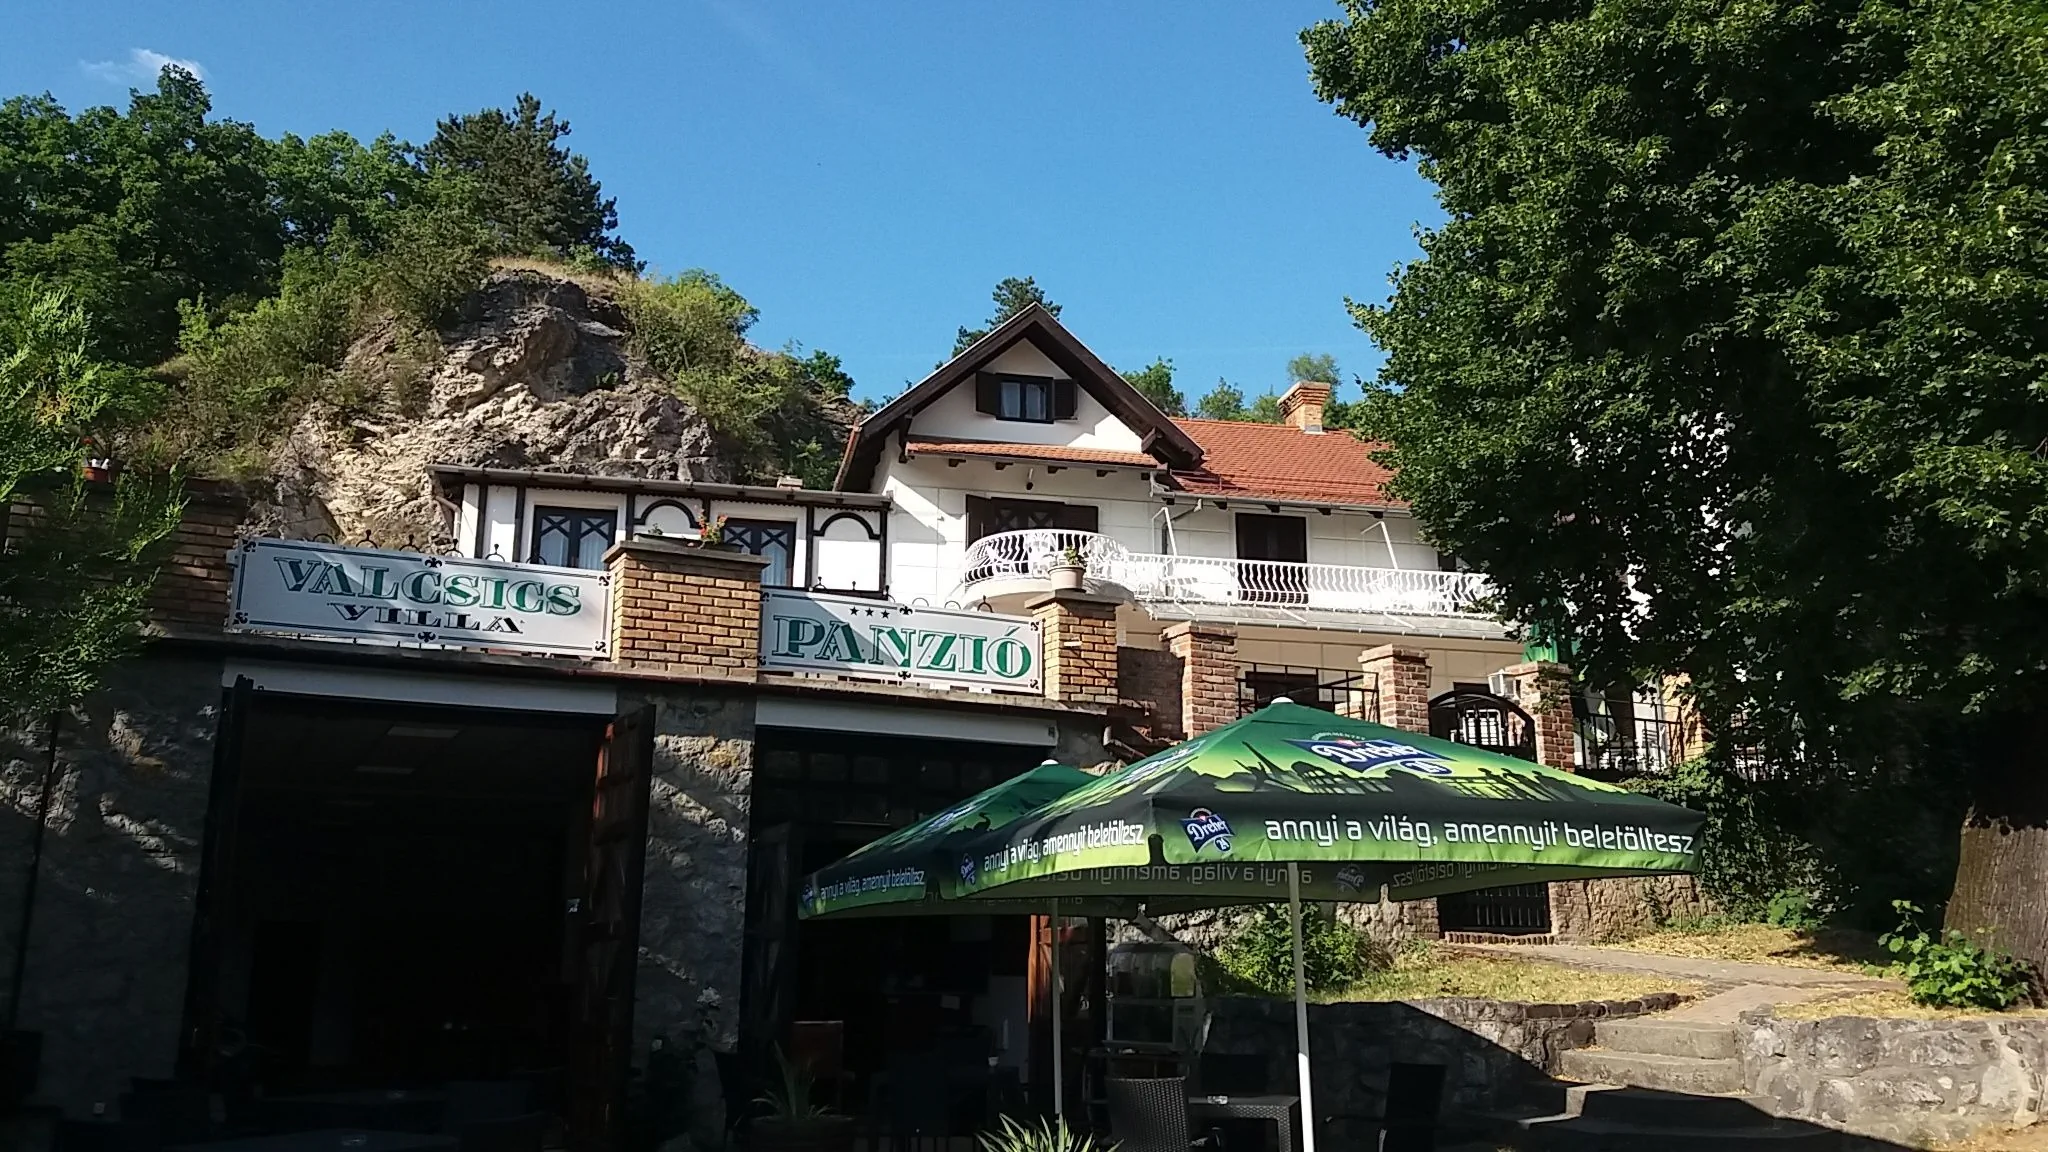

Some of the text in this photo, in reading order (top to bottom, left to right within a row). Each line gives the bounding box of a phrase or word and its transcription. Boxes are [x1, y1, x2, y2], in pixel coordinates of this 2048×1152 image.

[274, 556, 583, 616] VALCSICS
[327, 602, 524, 635] VILLA
[772, 615, 1032, 678] PANZIÓ
[984, 843, 1009, 872] annyi
[1010, 846, 1017, 864] a
[1043, 828, 1086, 856] amennyit
[1087, 819, 1145, 846] beletöltesz
[1186, 818, 1226, 842] Dreher
[1265, 814, 1695, 854] annyi a világ, amennyit beletöltesz
